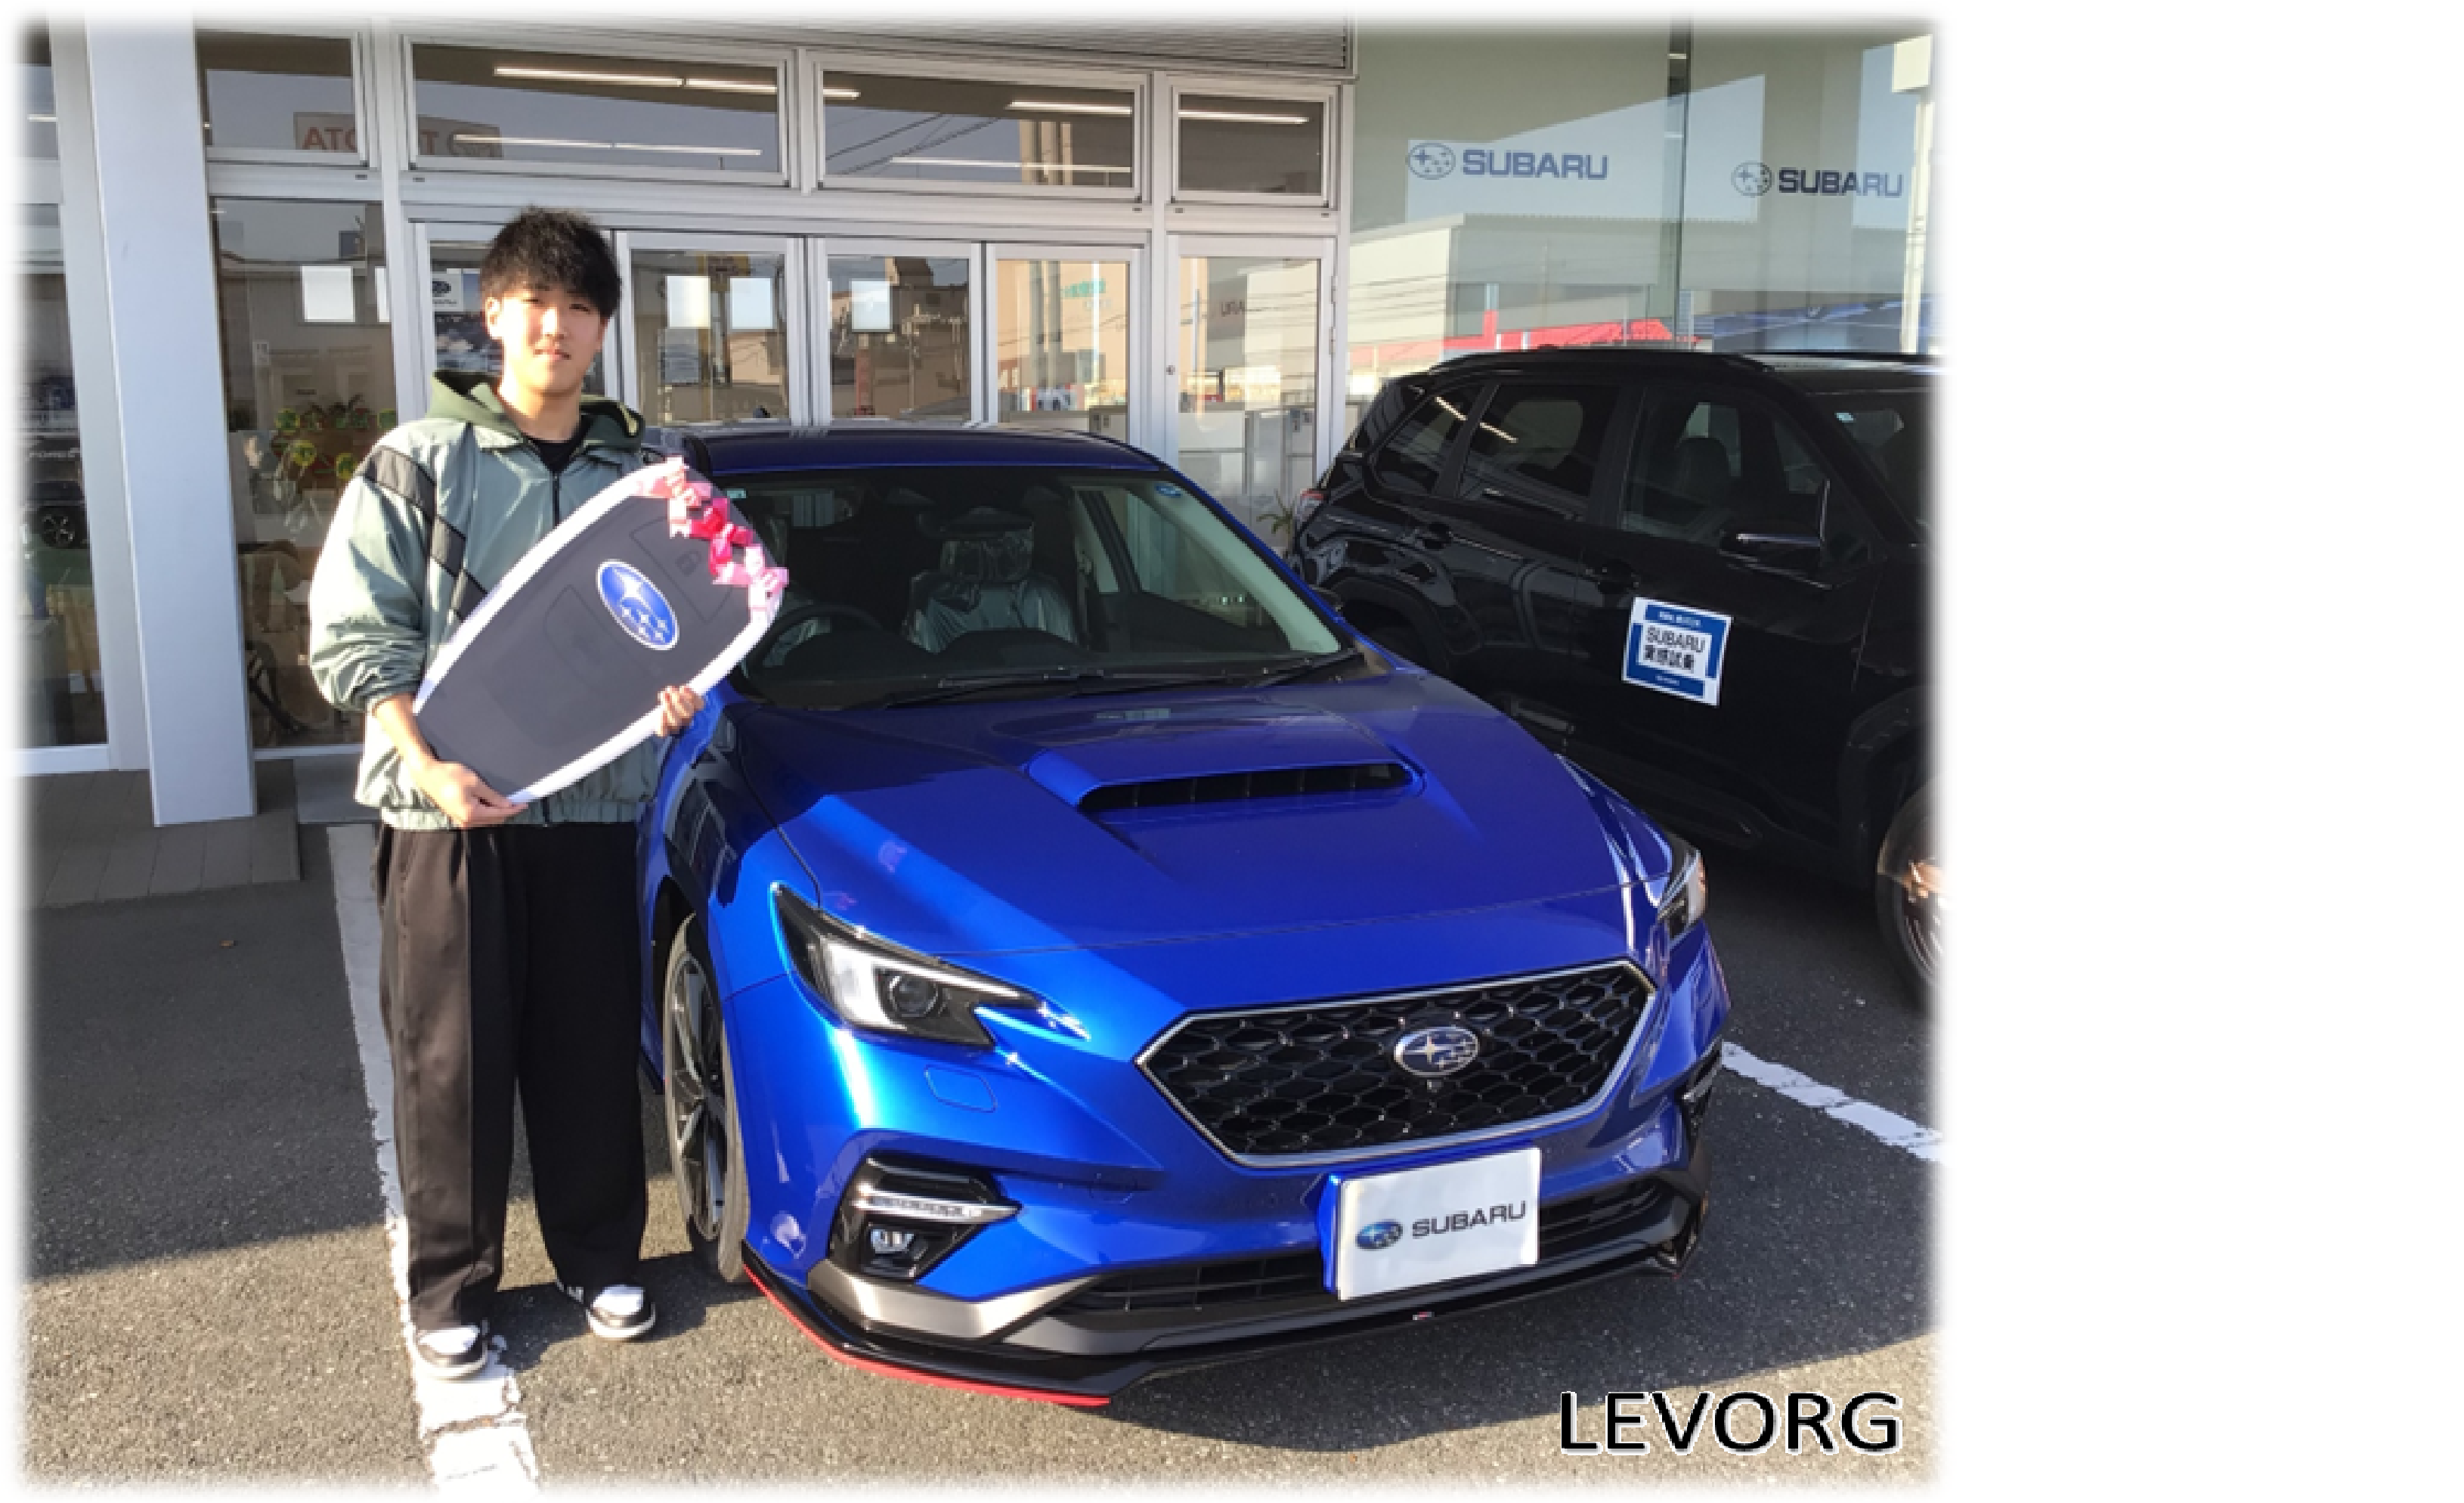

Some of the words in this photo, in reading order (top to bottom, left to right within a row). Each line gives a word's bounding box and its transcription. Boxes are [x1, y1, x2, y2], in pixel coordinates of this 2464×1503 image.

[1463, 149, 1608, 180] SUBARU
[1778, 167, 1902, 198] SUBARU
[1646, 625, 1706, 653] SUBARU
[1412, 1201, 1526, 1239] SUBARU
